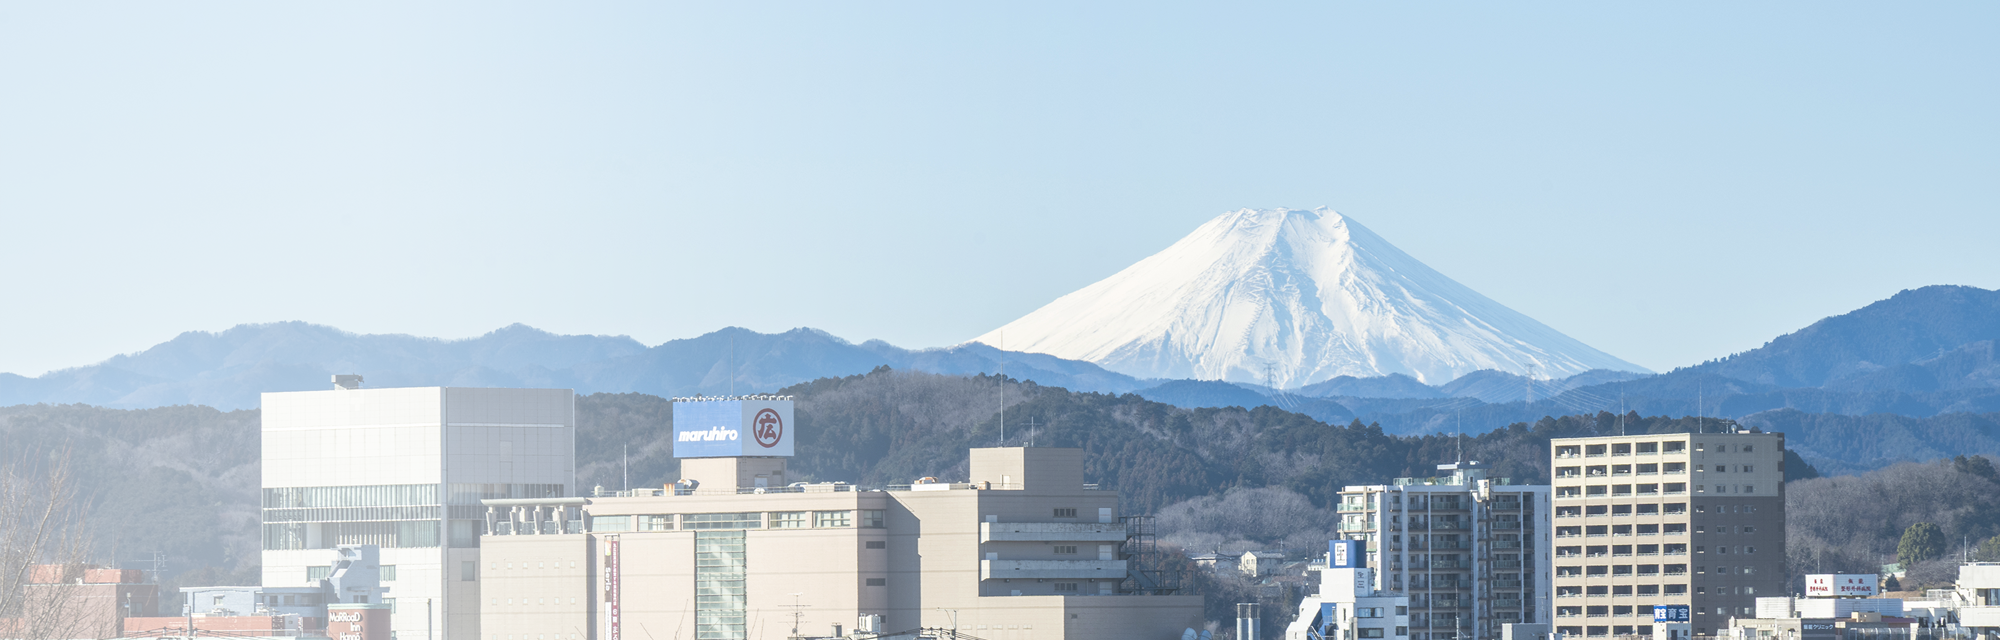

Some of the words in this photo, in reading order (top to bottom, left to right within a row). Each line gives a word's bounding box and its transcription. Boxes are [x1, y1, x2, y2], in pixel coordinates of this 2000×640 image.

[678, 426, 738, 441] maruhiro
[1668, 608, 1688, 619] 育宝
[350, 622, 360, 631] Inn
